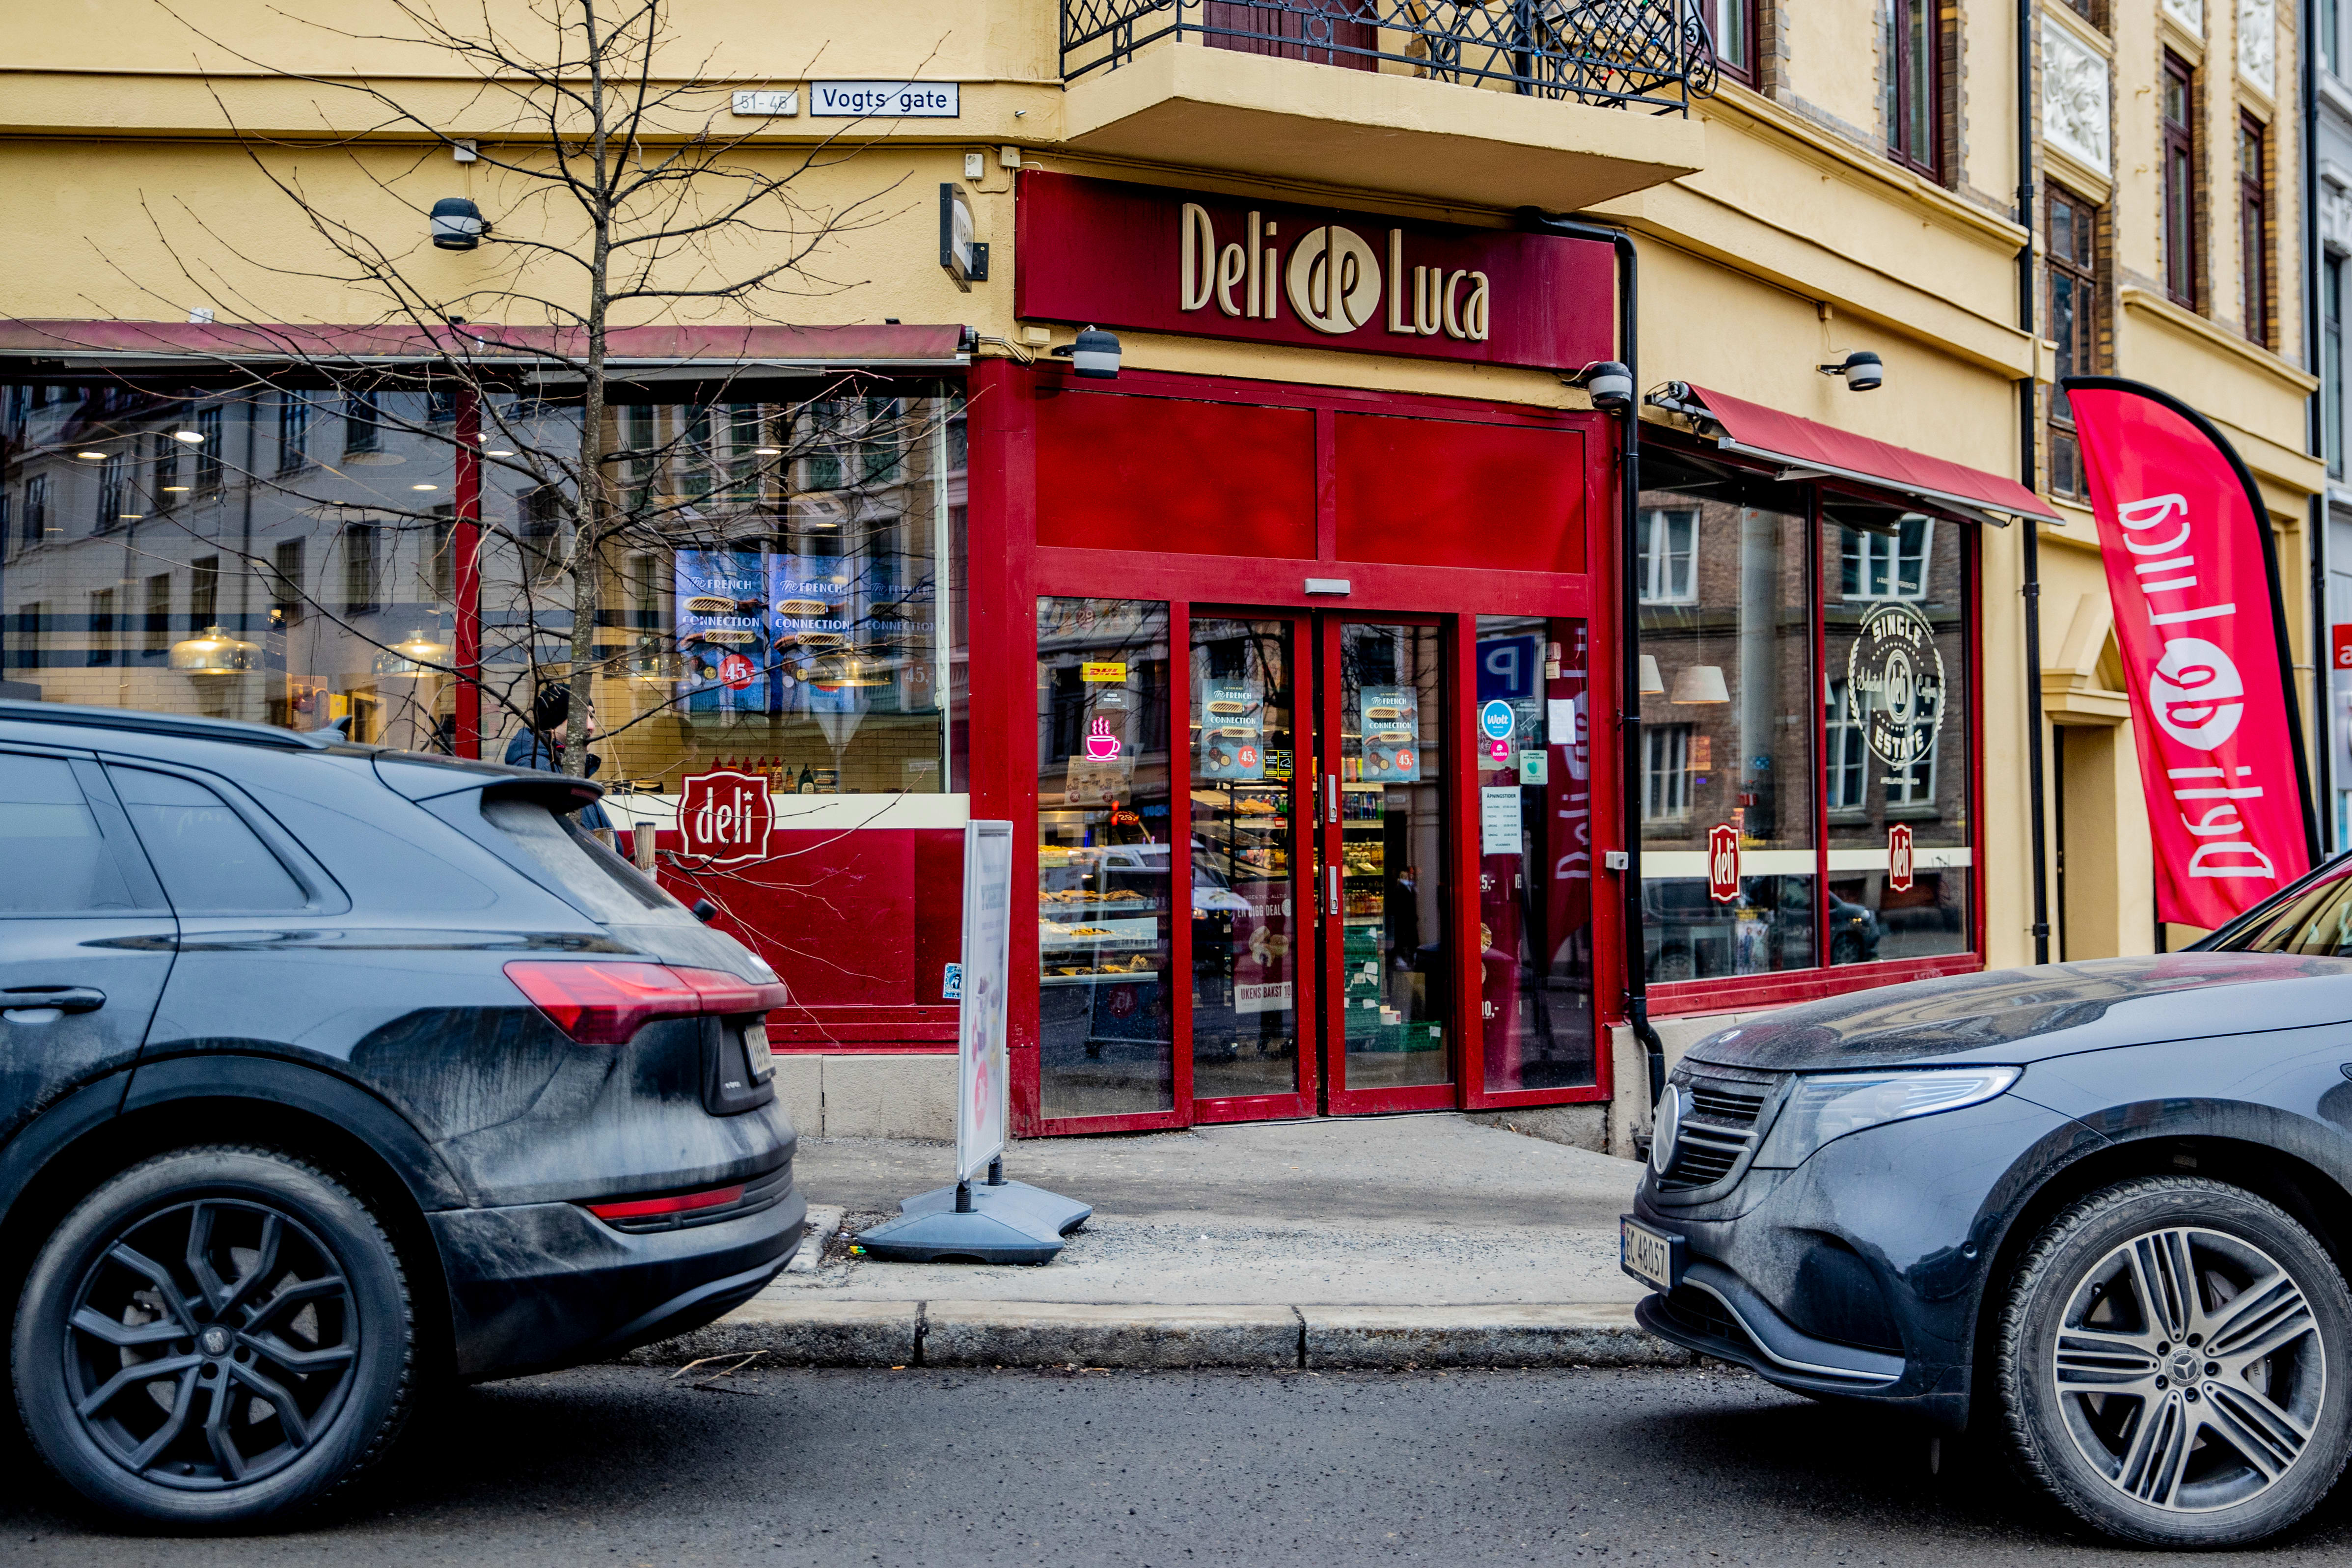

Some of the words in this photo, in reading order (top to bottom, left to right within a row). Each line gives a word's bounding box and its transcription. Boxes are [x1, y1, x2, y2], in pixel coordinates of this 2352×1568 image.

[822, 88, 885, 112] Vogts
[900, 90, 947, 112] gate
[1181, 202, 1278, 319] Deli
[1286, 225, 1381, 334] de
[1389, 228, 1489, 341] Luca
[2117, 493, 2236, 626] Luca
[687, 577, 706, 593] The
[707, 579, 752, 590] FRENCH
[780, 579, 798, 594] The
[799, 583, 843, 594] FRENCH
[682, 616, 760, 627] CONNECTION
[775, 618, 850, 630] CONNECTION
[1872, 614, 1922, 649] SINGLE
[1089, 668, 1121, 676] DHL
[1487, 714, 1509, 725] Wolt
[1874, 725, 1924, 759] ESTATE
[1241, 751, 1258, 764] 45,-
[1398, 754, 1415, 766] 45,-
[696, 787, 755, 844] deli
[2167, 766, 2274, 879] Deli
[1714, 837, 1735, 885] deli
[1892, 835, 1910, 879] deli
[1265, 904, 1282, 916] DEAL
[1240, 987, 1261, 1000] UKENS
[1263, 985, 1283, 998] BAKST
[1626, 1227, 1635, 1264] EC
[1638, 1234, 1665, 1279] 48057
